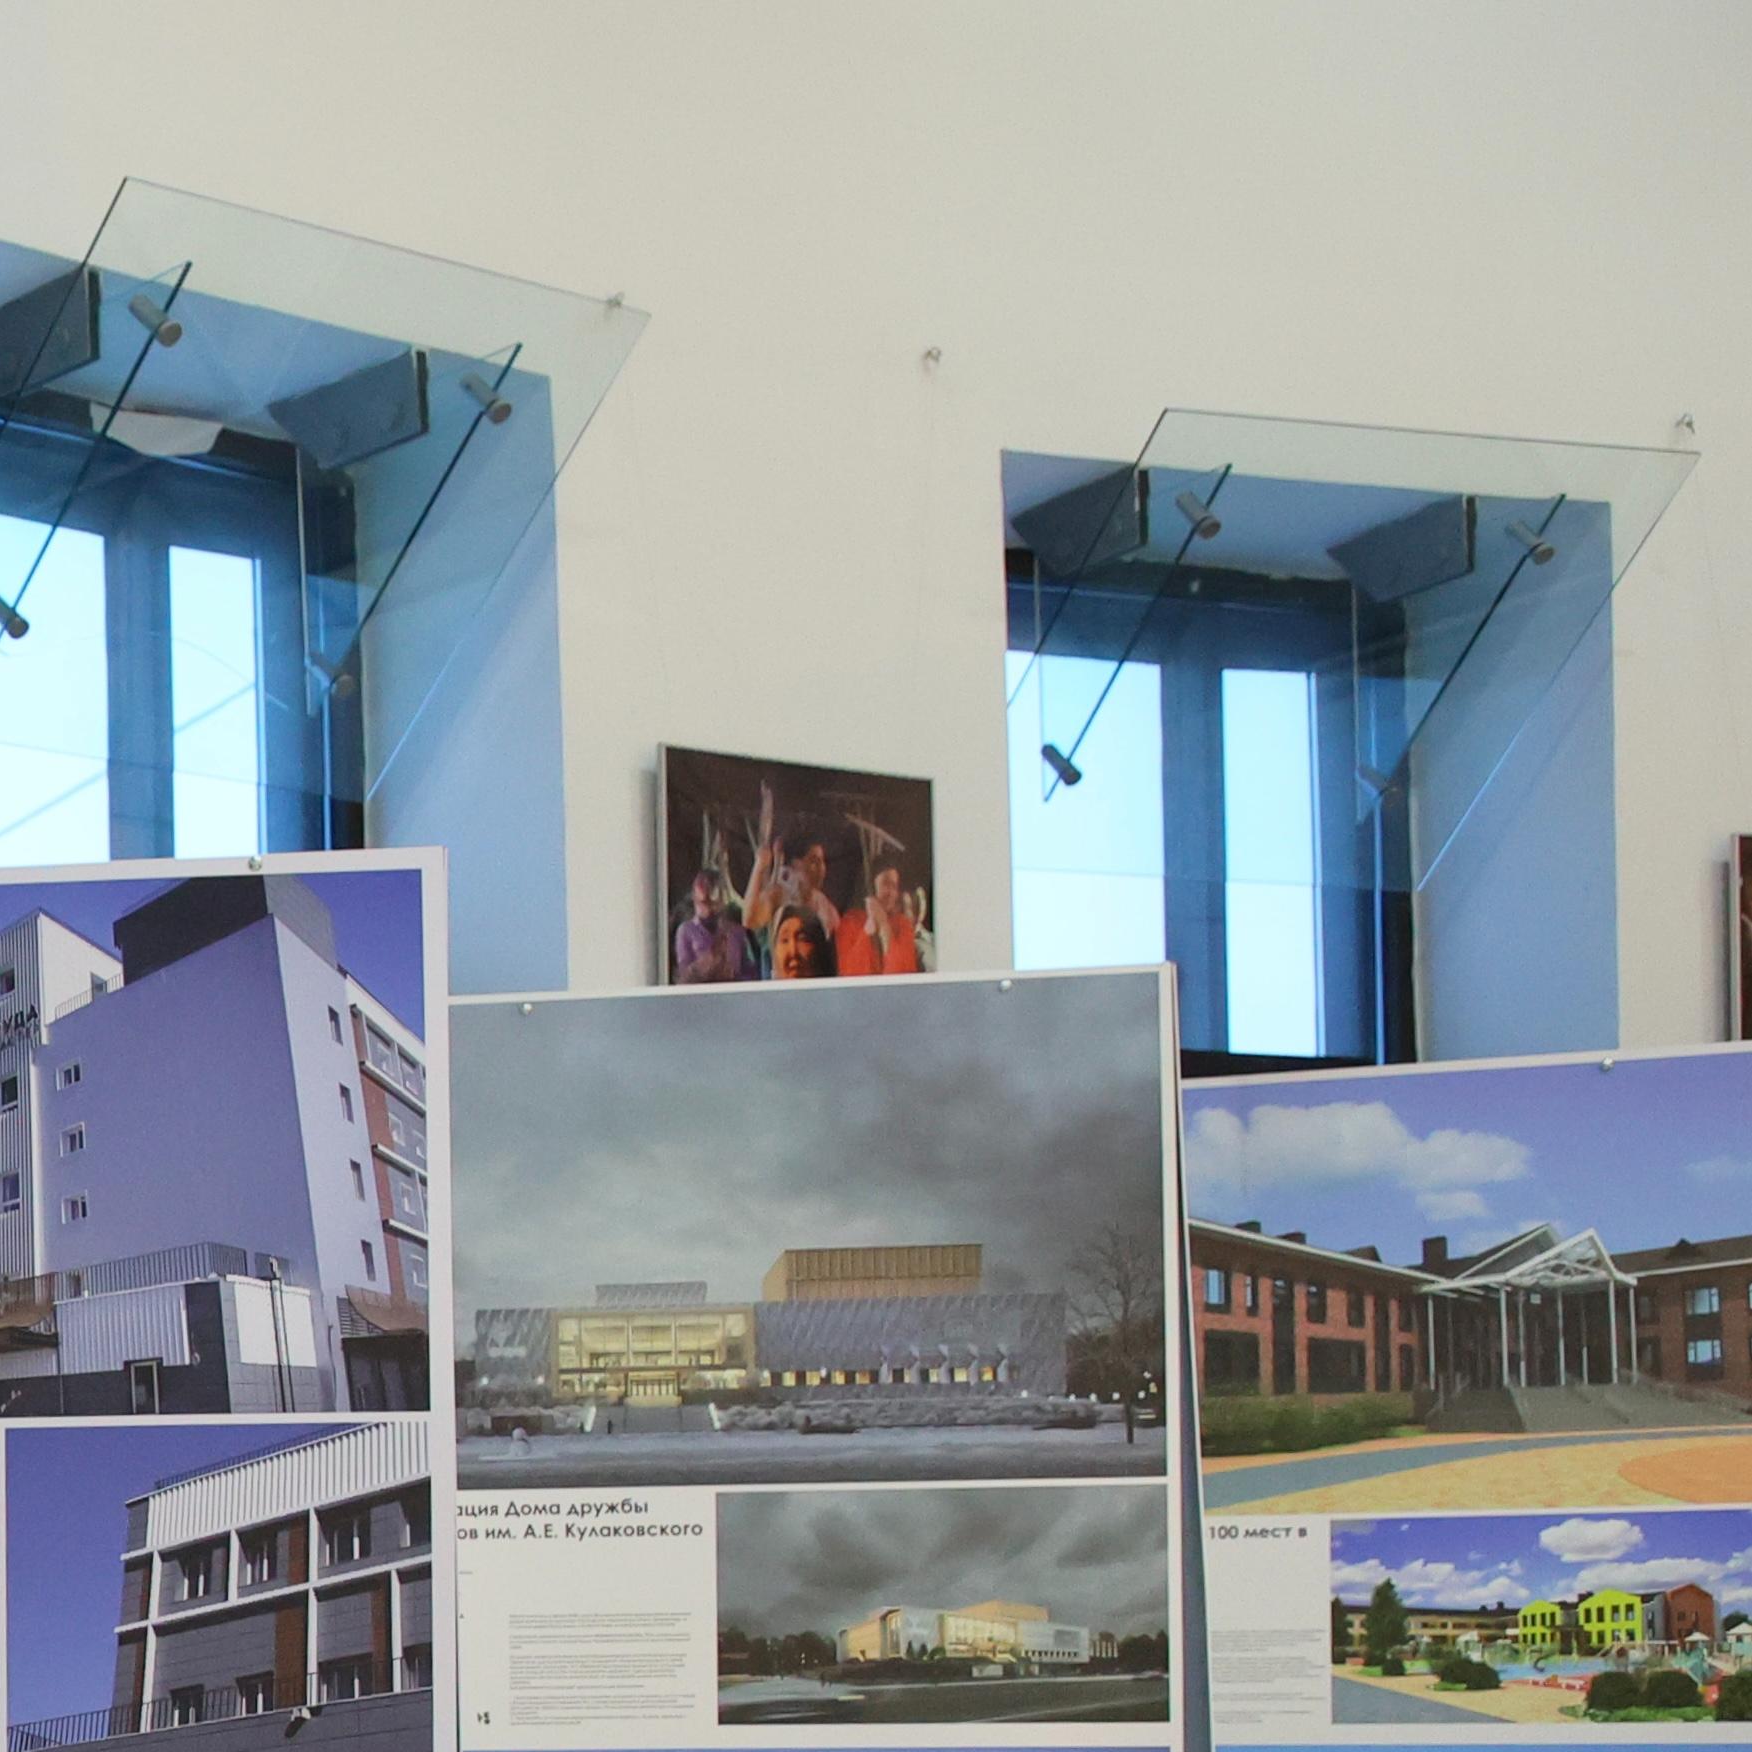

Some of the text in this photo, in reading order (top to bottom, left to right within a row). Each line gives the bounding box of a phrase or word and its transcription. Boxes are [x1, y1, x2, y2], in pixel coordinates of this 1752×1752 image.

[504, 1500, 560, 1517] Дома
[566, 1497, 648, 1518] дружбы
[523, 1523, 557, 1538] А.Е.
[565, 1521, 703, 1541] Кулаковского
[1209, 1525, 1239, 1539] 100
[1243, 1527, 1292, 1538] мест
